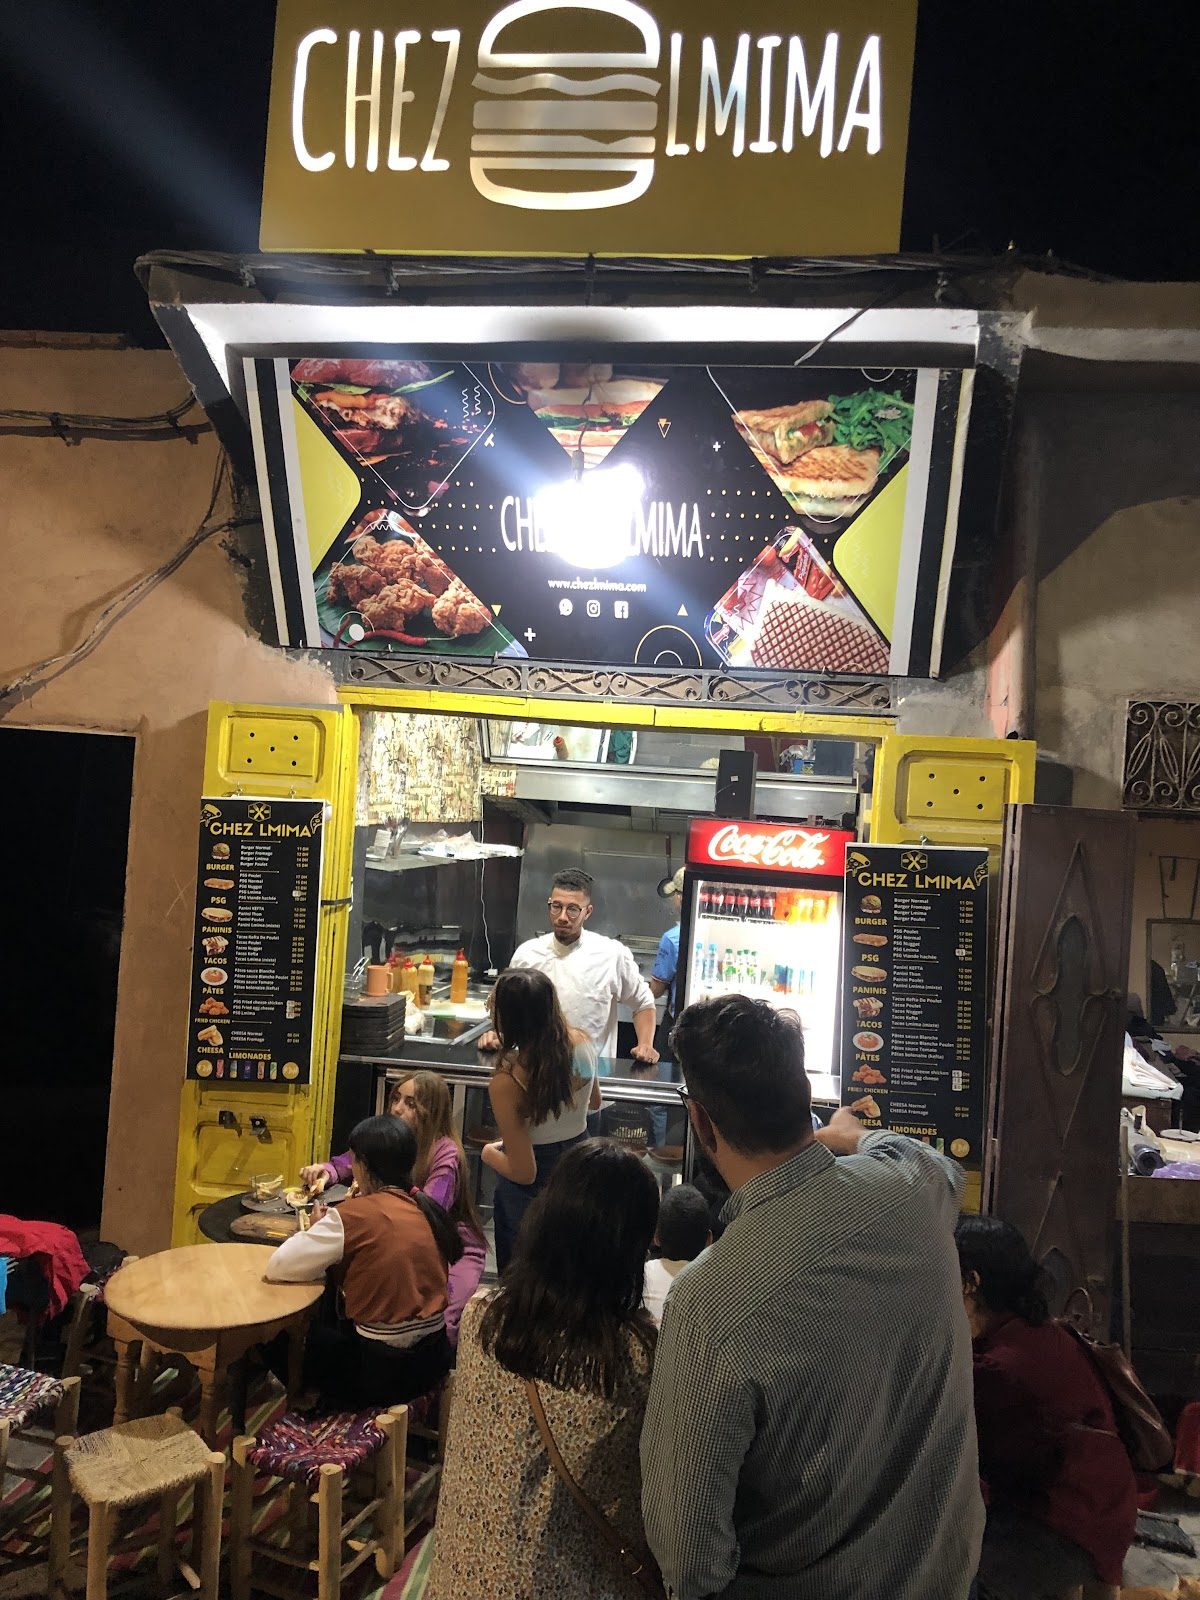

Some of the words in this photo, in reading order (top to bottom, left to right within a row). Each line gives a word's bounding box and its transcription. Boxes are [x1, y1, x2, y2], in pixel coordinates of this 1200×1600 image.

[292, 28, 461, 172] CHEZ
[665, 33, 881, 159] LMIMA
[210, 822, 254, 836] CHEZ
[260, 823, 311, 837] LMIMA
[708, 825, 829, 869] Coca-Cola
[206, 863, 235, 871] BURGER
[858, 872, 908, 887] CHEZ
[915, 874, 976, 890] LMIMA
[855, 917, 887, 926] BURGER
[202, 926, 232, 934] PANINIS
[203, 957, 227, 965] TACOS
[861, 954, 879, 962] PSG
[202, 987, 224, 995] PÂTES
[852, 986, 887, 995] PANINIS
[197, 1046, 224, 1054] CHEESA
[229, 1052, 271, 1060] LIMONADES
[855, 1052, 880, 1061] PÂTES
[888, 1125, 937, 1135] LIMONADES
